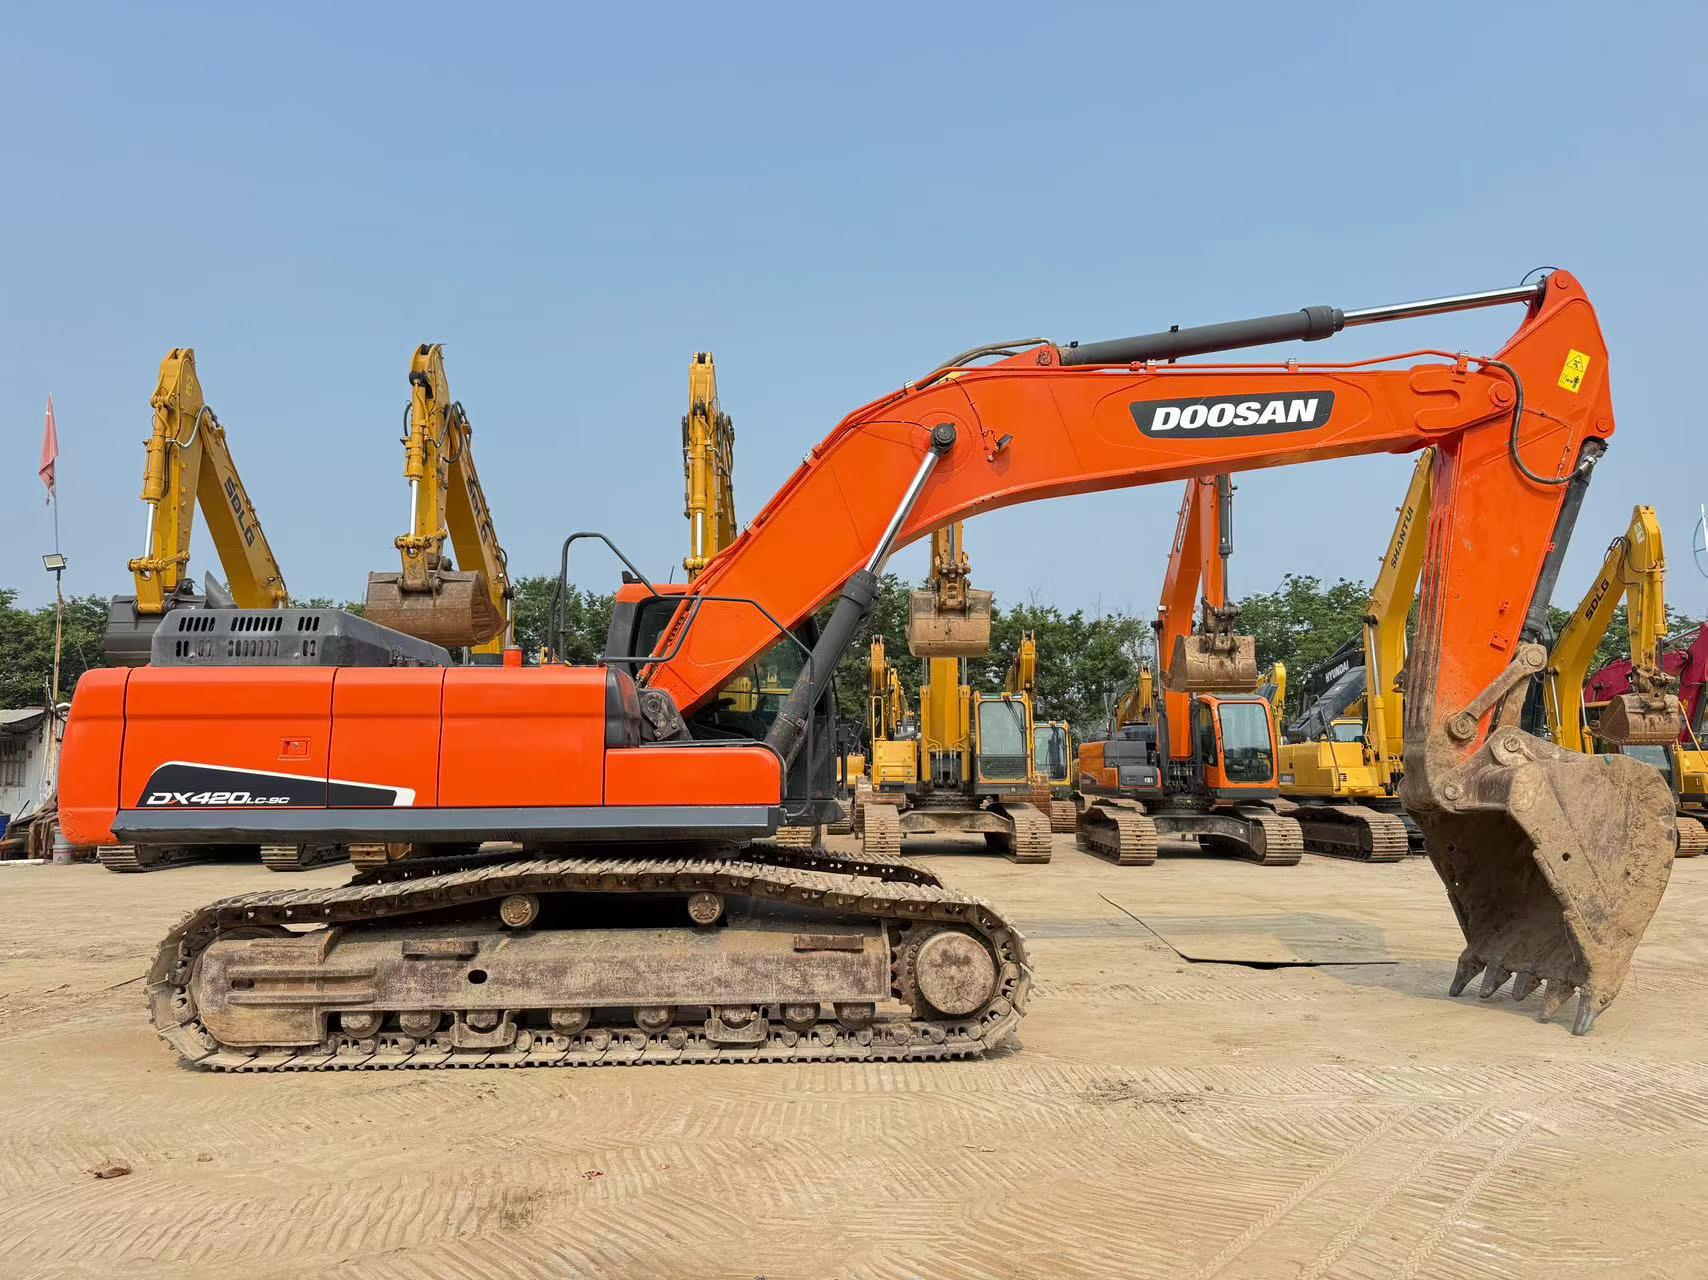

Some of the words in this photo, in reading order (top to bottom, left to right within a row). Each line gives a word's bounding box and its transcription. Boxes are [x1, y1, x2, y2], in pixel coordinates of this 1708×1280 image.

[1151, 398, 1319, 431] DOOSAN
[224, 475, 255, 548] SDLG
[1391, 506, 1414, 569] SHANTUI
[1585, 578, 1610, 621] SDLG
